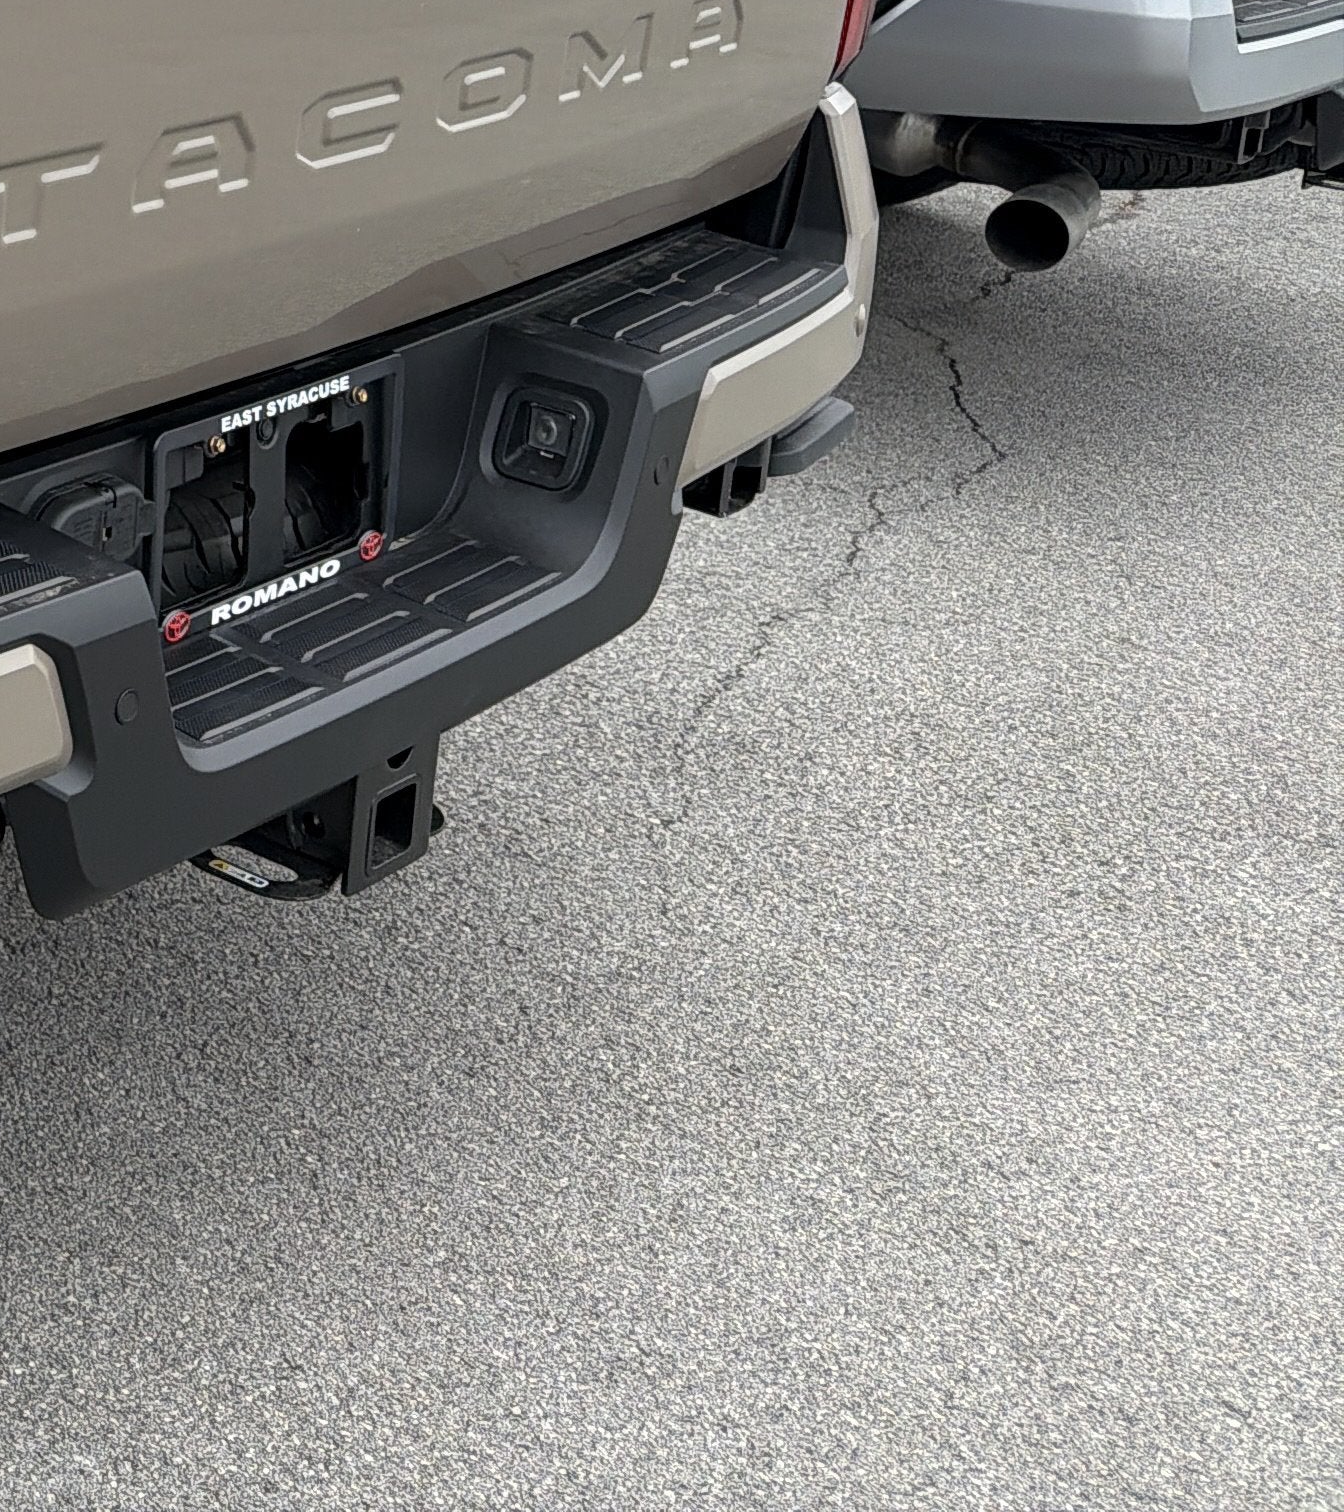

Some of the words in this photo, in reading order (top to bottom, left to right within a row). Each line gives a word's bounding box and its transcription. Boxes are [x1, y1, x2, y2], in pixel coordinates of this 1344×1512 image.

[221, 406, 262, 432] EAST
[266, 375, 350, 419] SYRACUSE
[211, 558, 341, 625] ROMANO
